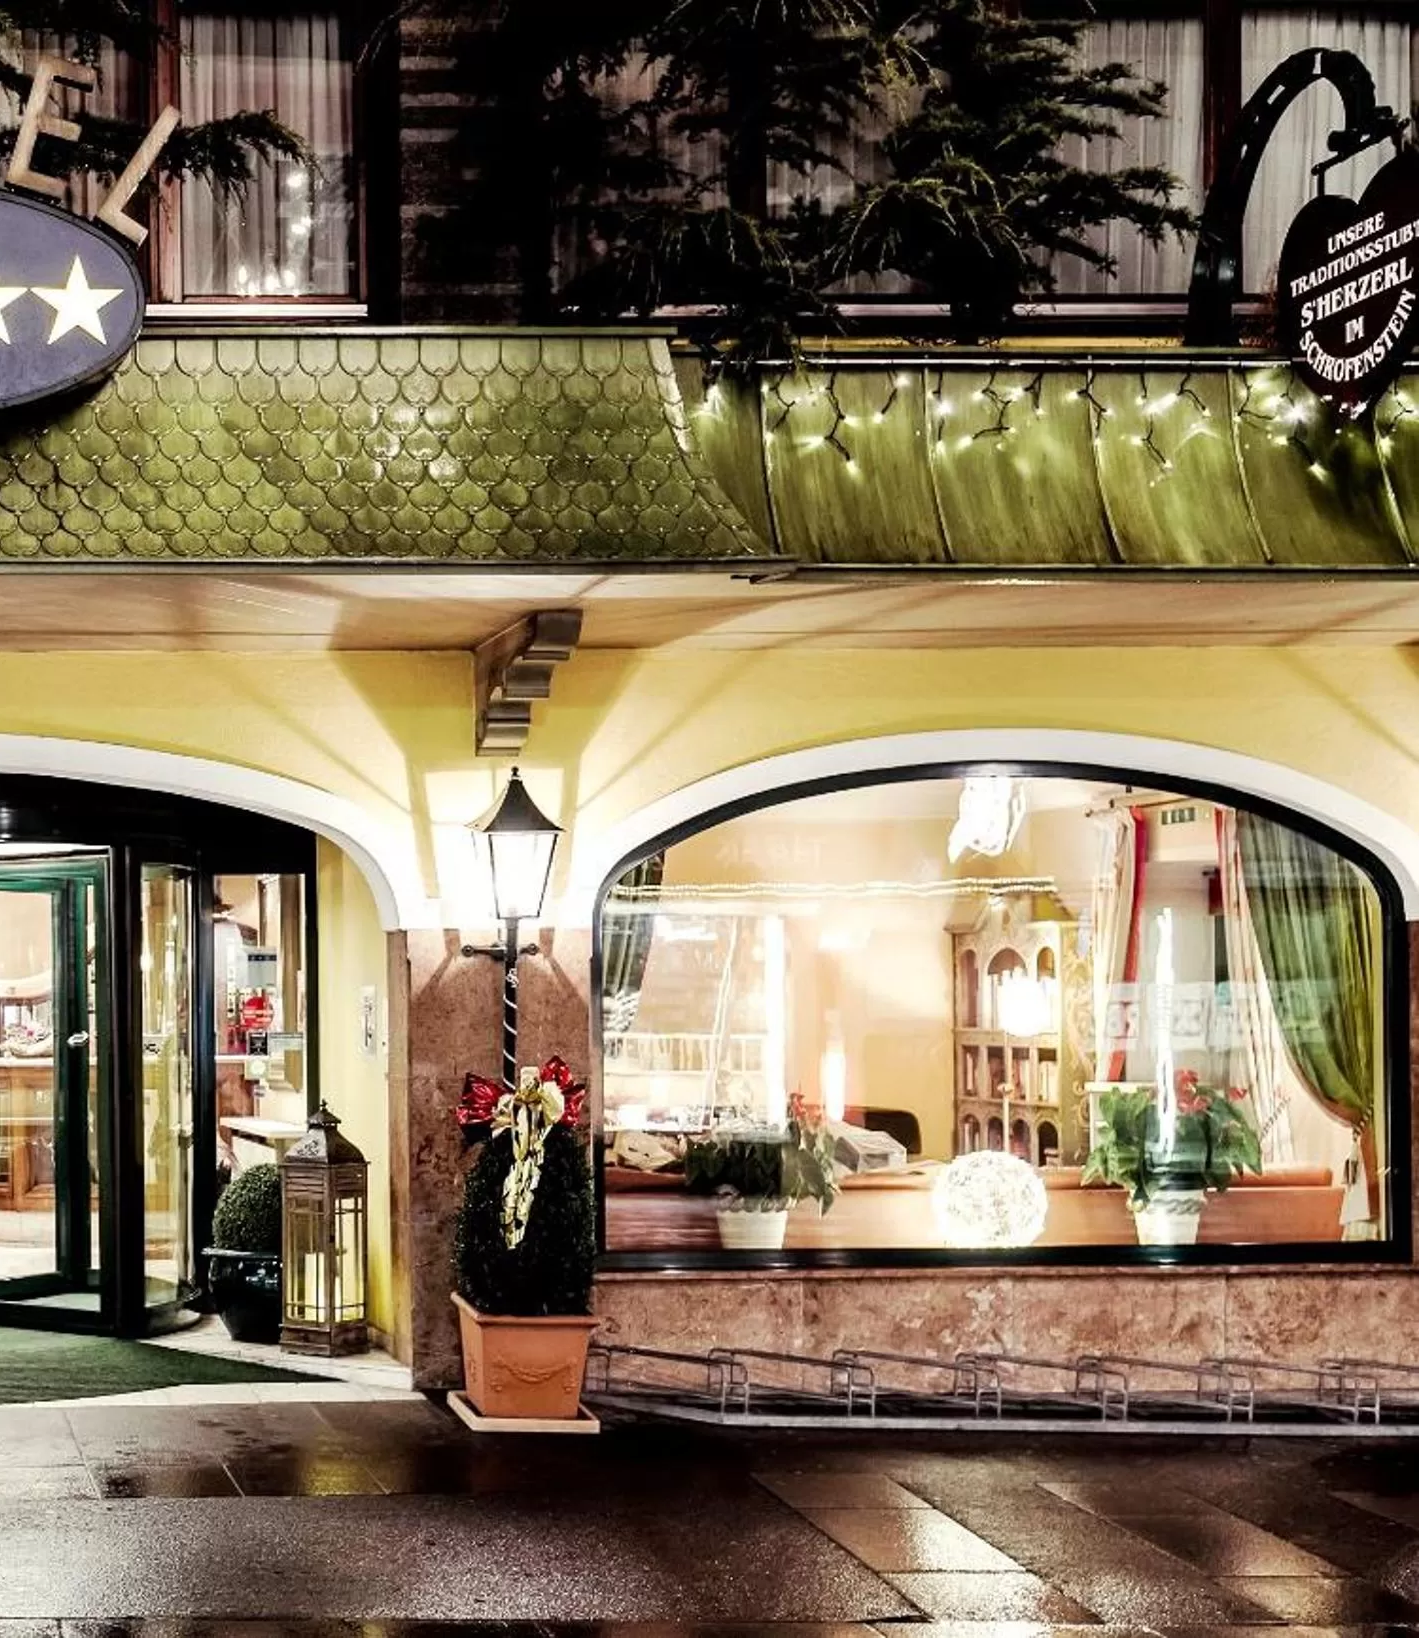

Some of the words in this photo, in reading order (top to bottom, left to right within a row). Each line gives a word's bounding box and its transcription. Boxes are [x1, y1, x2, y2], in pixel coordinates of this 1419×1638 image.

[1327, 211, 1385, 254] UNSERE
[1300, 257, 1414, 328] S'HERZERL
[1299, 288, 1416, 382] SCHROFENSTEIN
[1344, 315, 1365, 345] IM
